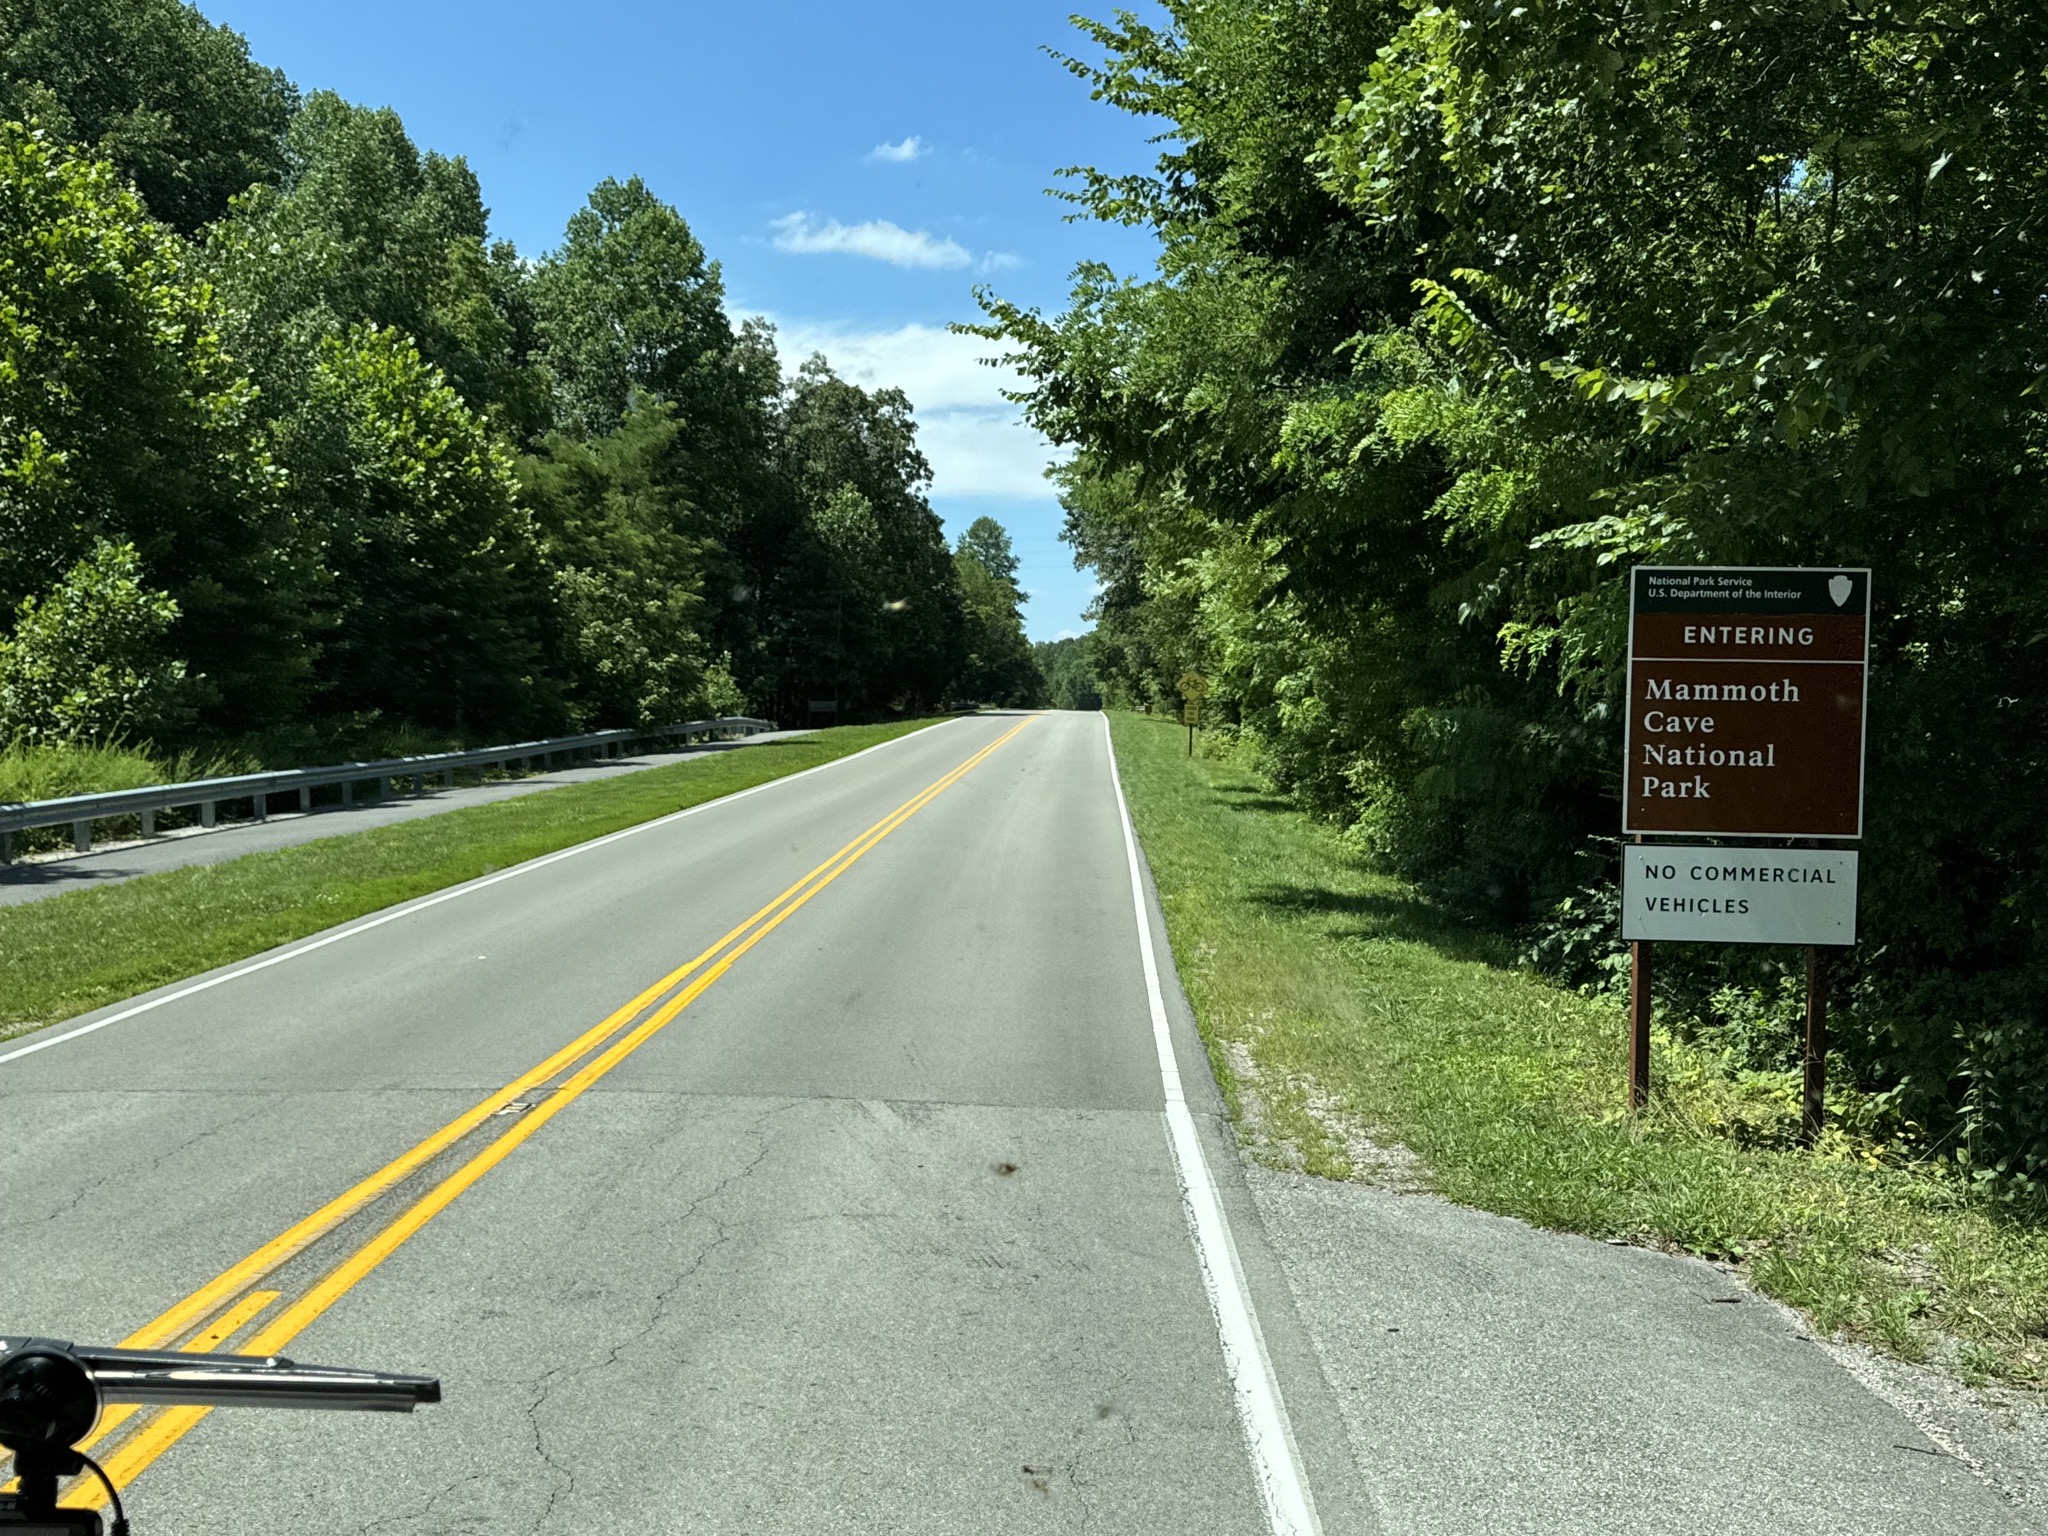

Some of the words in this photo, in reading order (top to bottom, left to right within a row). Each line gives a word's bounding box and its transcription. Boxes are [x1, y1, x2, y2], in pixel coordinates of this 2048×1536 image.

[1649, 576, 1690, 586] National
[1694, 576, 1714, 586] Park
[1718, 576, 1752, 586] Service
[1648, 588, 1667, 598] U.S.
[1670, 589, 1729, 599] Department
[1732, 590, 1742, 598] of
[1746, 590, 1761, 598] the
[1764, 590, 1802, 599] Interior
[1684, 626, 1814, 645] ENTERING
[1645, 679, 1800, 702] Mammoth
[1644, 711, 1714, 732] Cave
[1642, 744, 1775, 766] National
[1642, 776, 1710, 798] Park
[1646, 865, 1676, 879] NO
[1690, 866, 1836, 883] COMMERCIAL
[1645, 897, 1749, 914] VEHICLES
